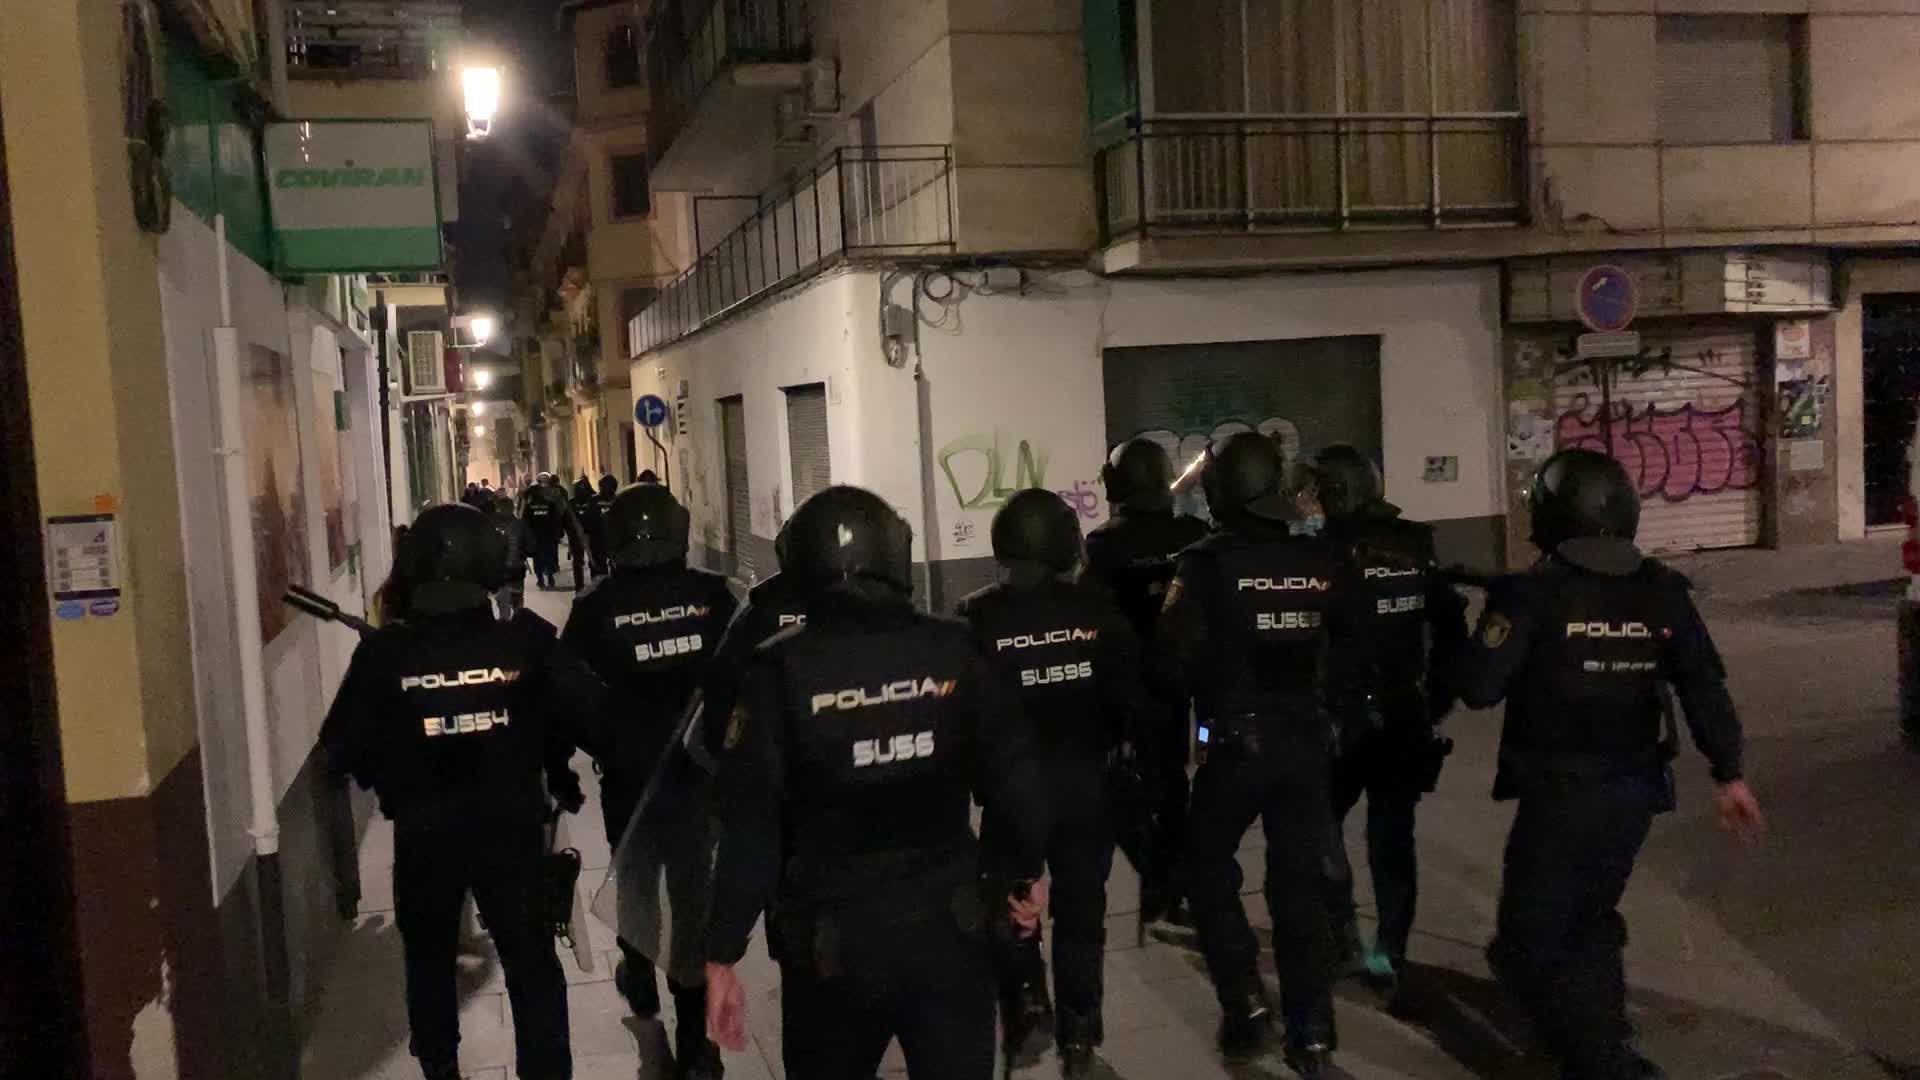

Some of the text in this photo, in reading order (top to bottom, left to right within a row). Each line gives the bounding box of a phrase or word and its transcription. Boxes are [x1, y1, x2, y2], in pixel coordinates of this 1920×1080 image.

[1238, 577, 1322, 591] POLICIA
[615, 605, 699, 628] POLICIA
[997, 628, 1086, 650] POLICIA
[402, 667, 505, 691] POLICIA
[812, 676, 938, 715] POLICIA
